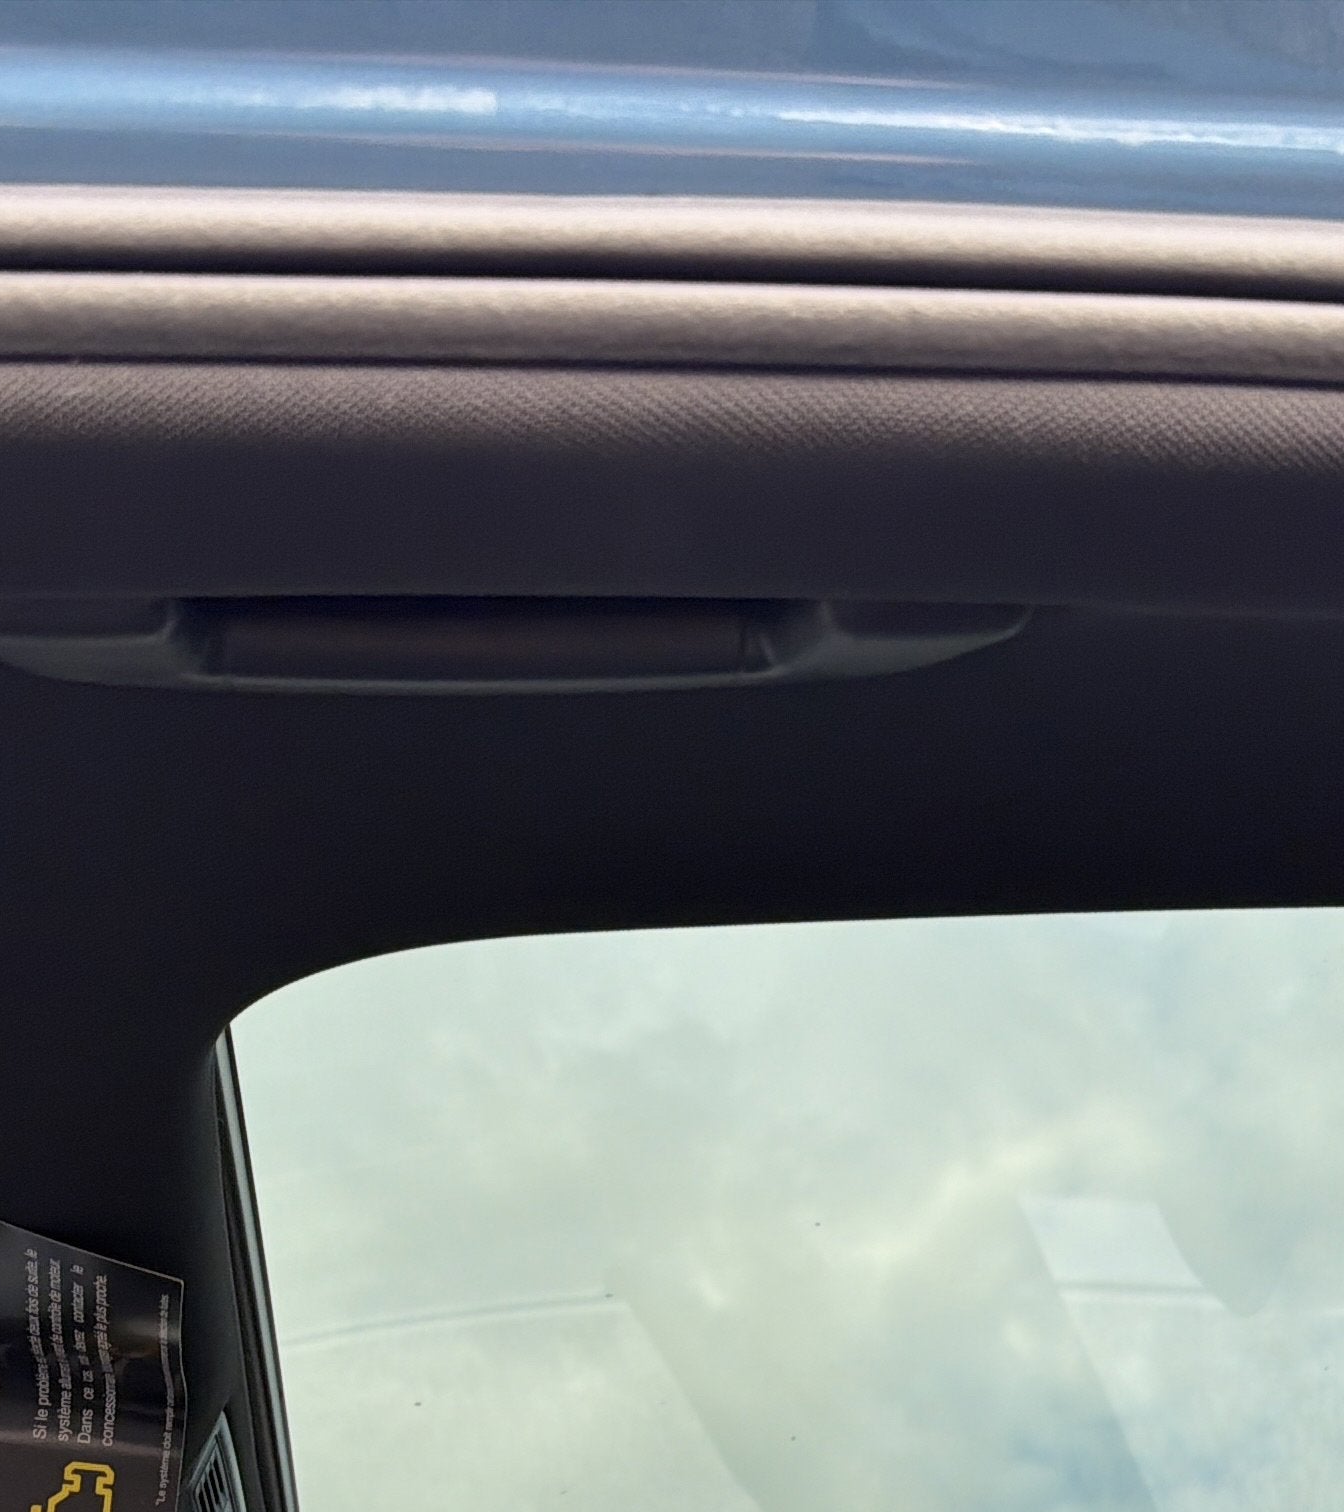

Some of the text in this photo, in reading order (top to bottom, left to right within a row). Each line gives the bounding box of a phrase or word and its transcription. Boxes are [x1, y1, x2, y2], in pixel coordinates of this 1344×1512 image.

[82, 1387, 94, 1400] ce
[34, 1409, 48, 1421] le
[56, 1390, 74, 1442] système
[34, 1423, 50, 1439] Si
[77, 1408, 94, 1444] Dans
